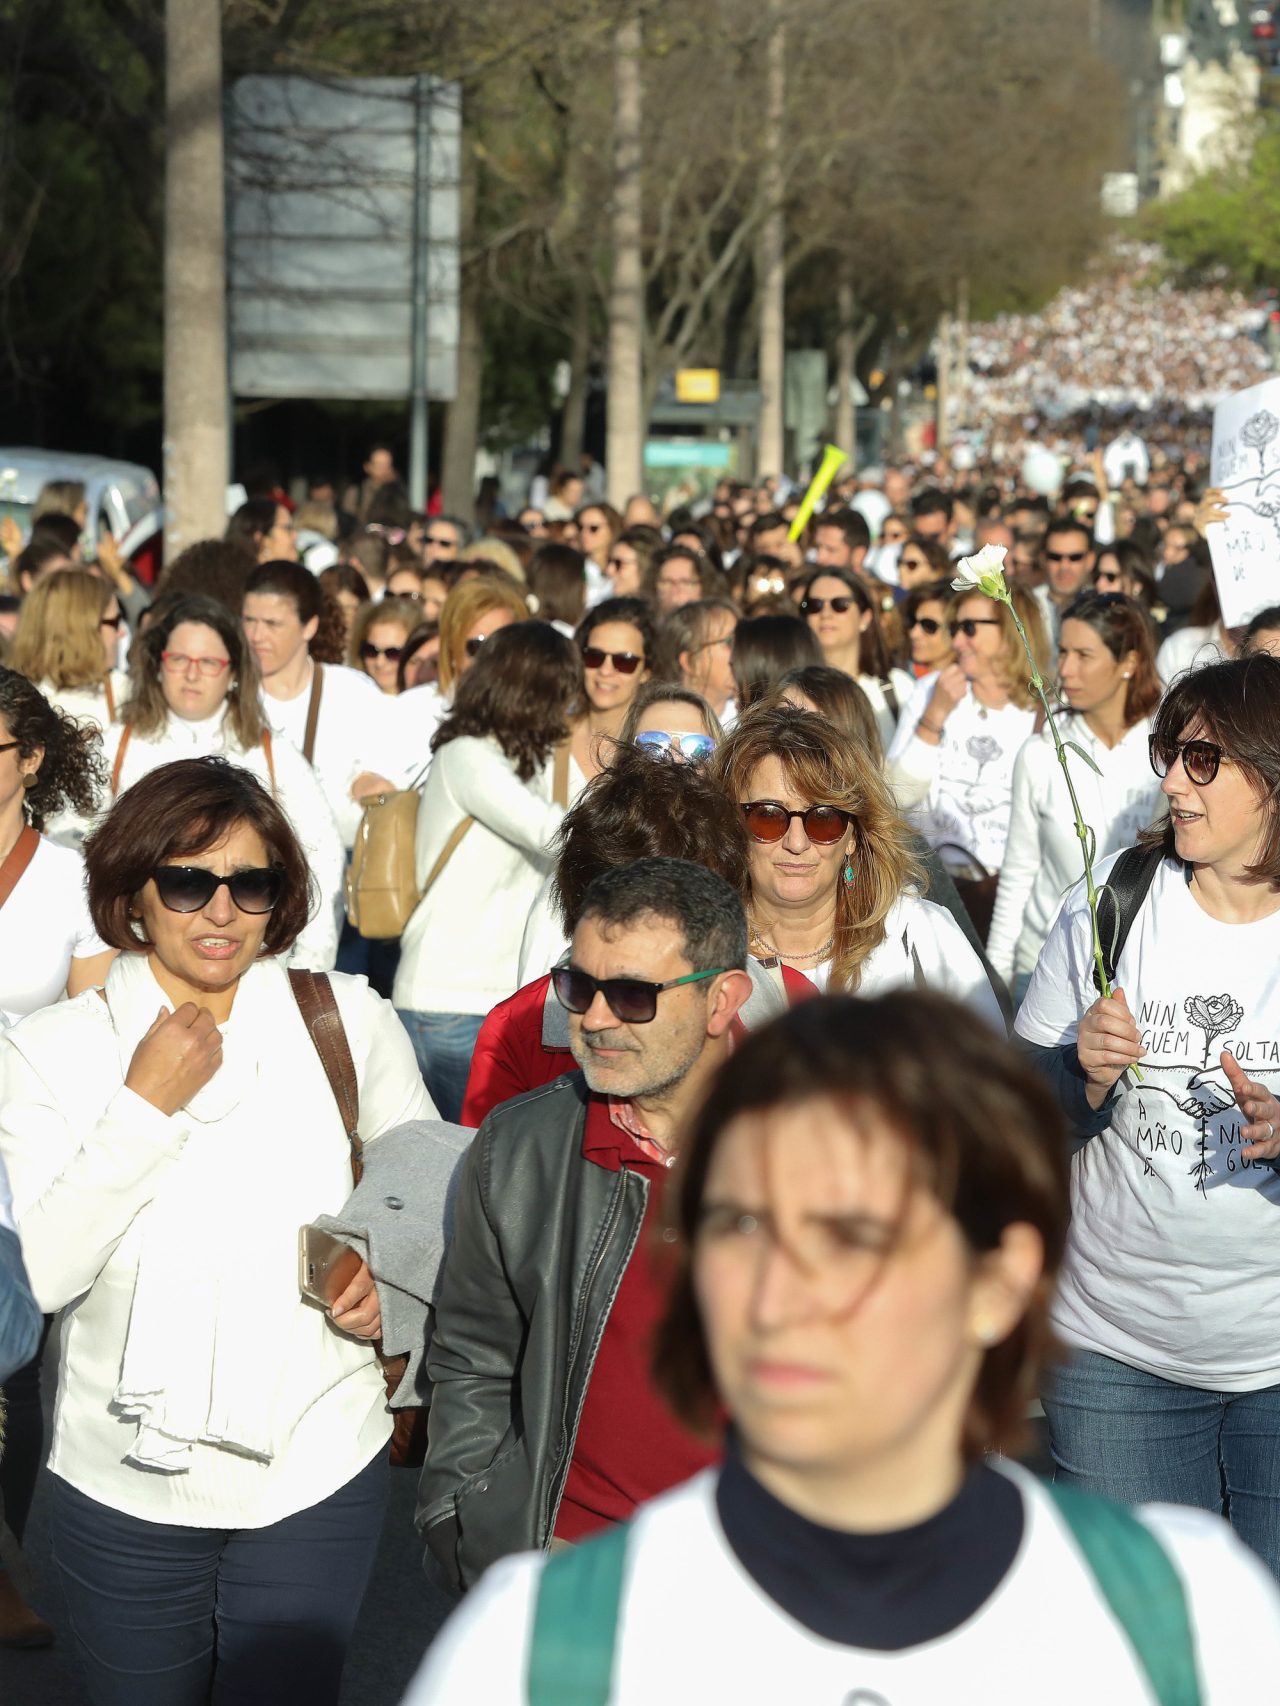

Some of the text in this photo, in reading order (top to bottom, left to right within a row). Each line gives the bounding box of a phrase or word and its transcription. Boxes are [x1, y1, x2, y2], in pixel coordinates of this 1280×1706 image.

[1139, 1025, 1190, 1056] GUÉM
[1138, 1098, 1147, 1121] A
[1136, 1122, 1183, 1156] MÃO
